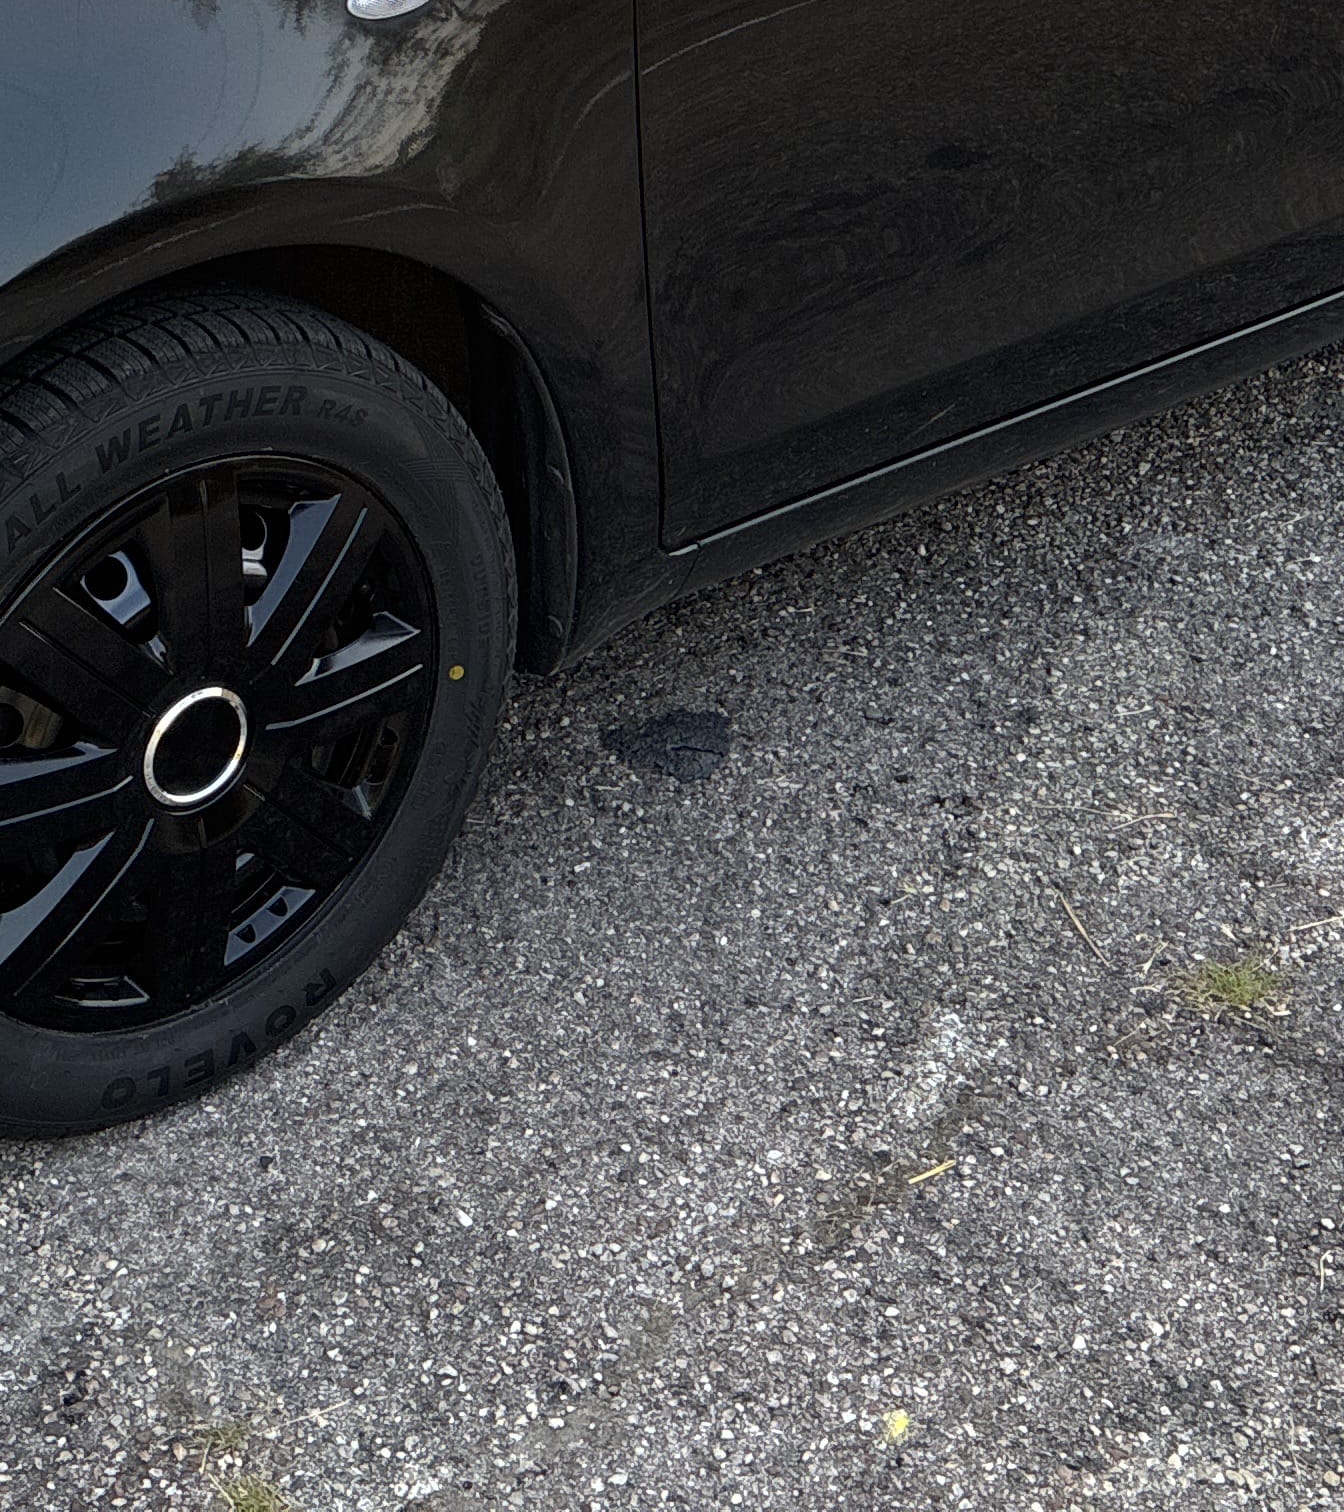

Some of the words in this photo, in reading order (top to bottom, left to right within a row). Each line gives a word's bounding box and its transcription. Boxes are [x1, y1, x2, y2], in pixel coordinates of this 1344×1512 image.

[3, 471, 82, 554] ALL
[94, 384, 309, 475] WEATHER
[101, 967, 337, 1112] ROVELO
